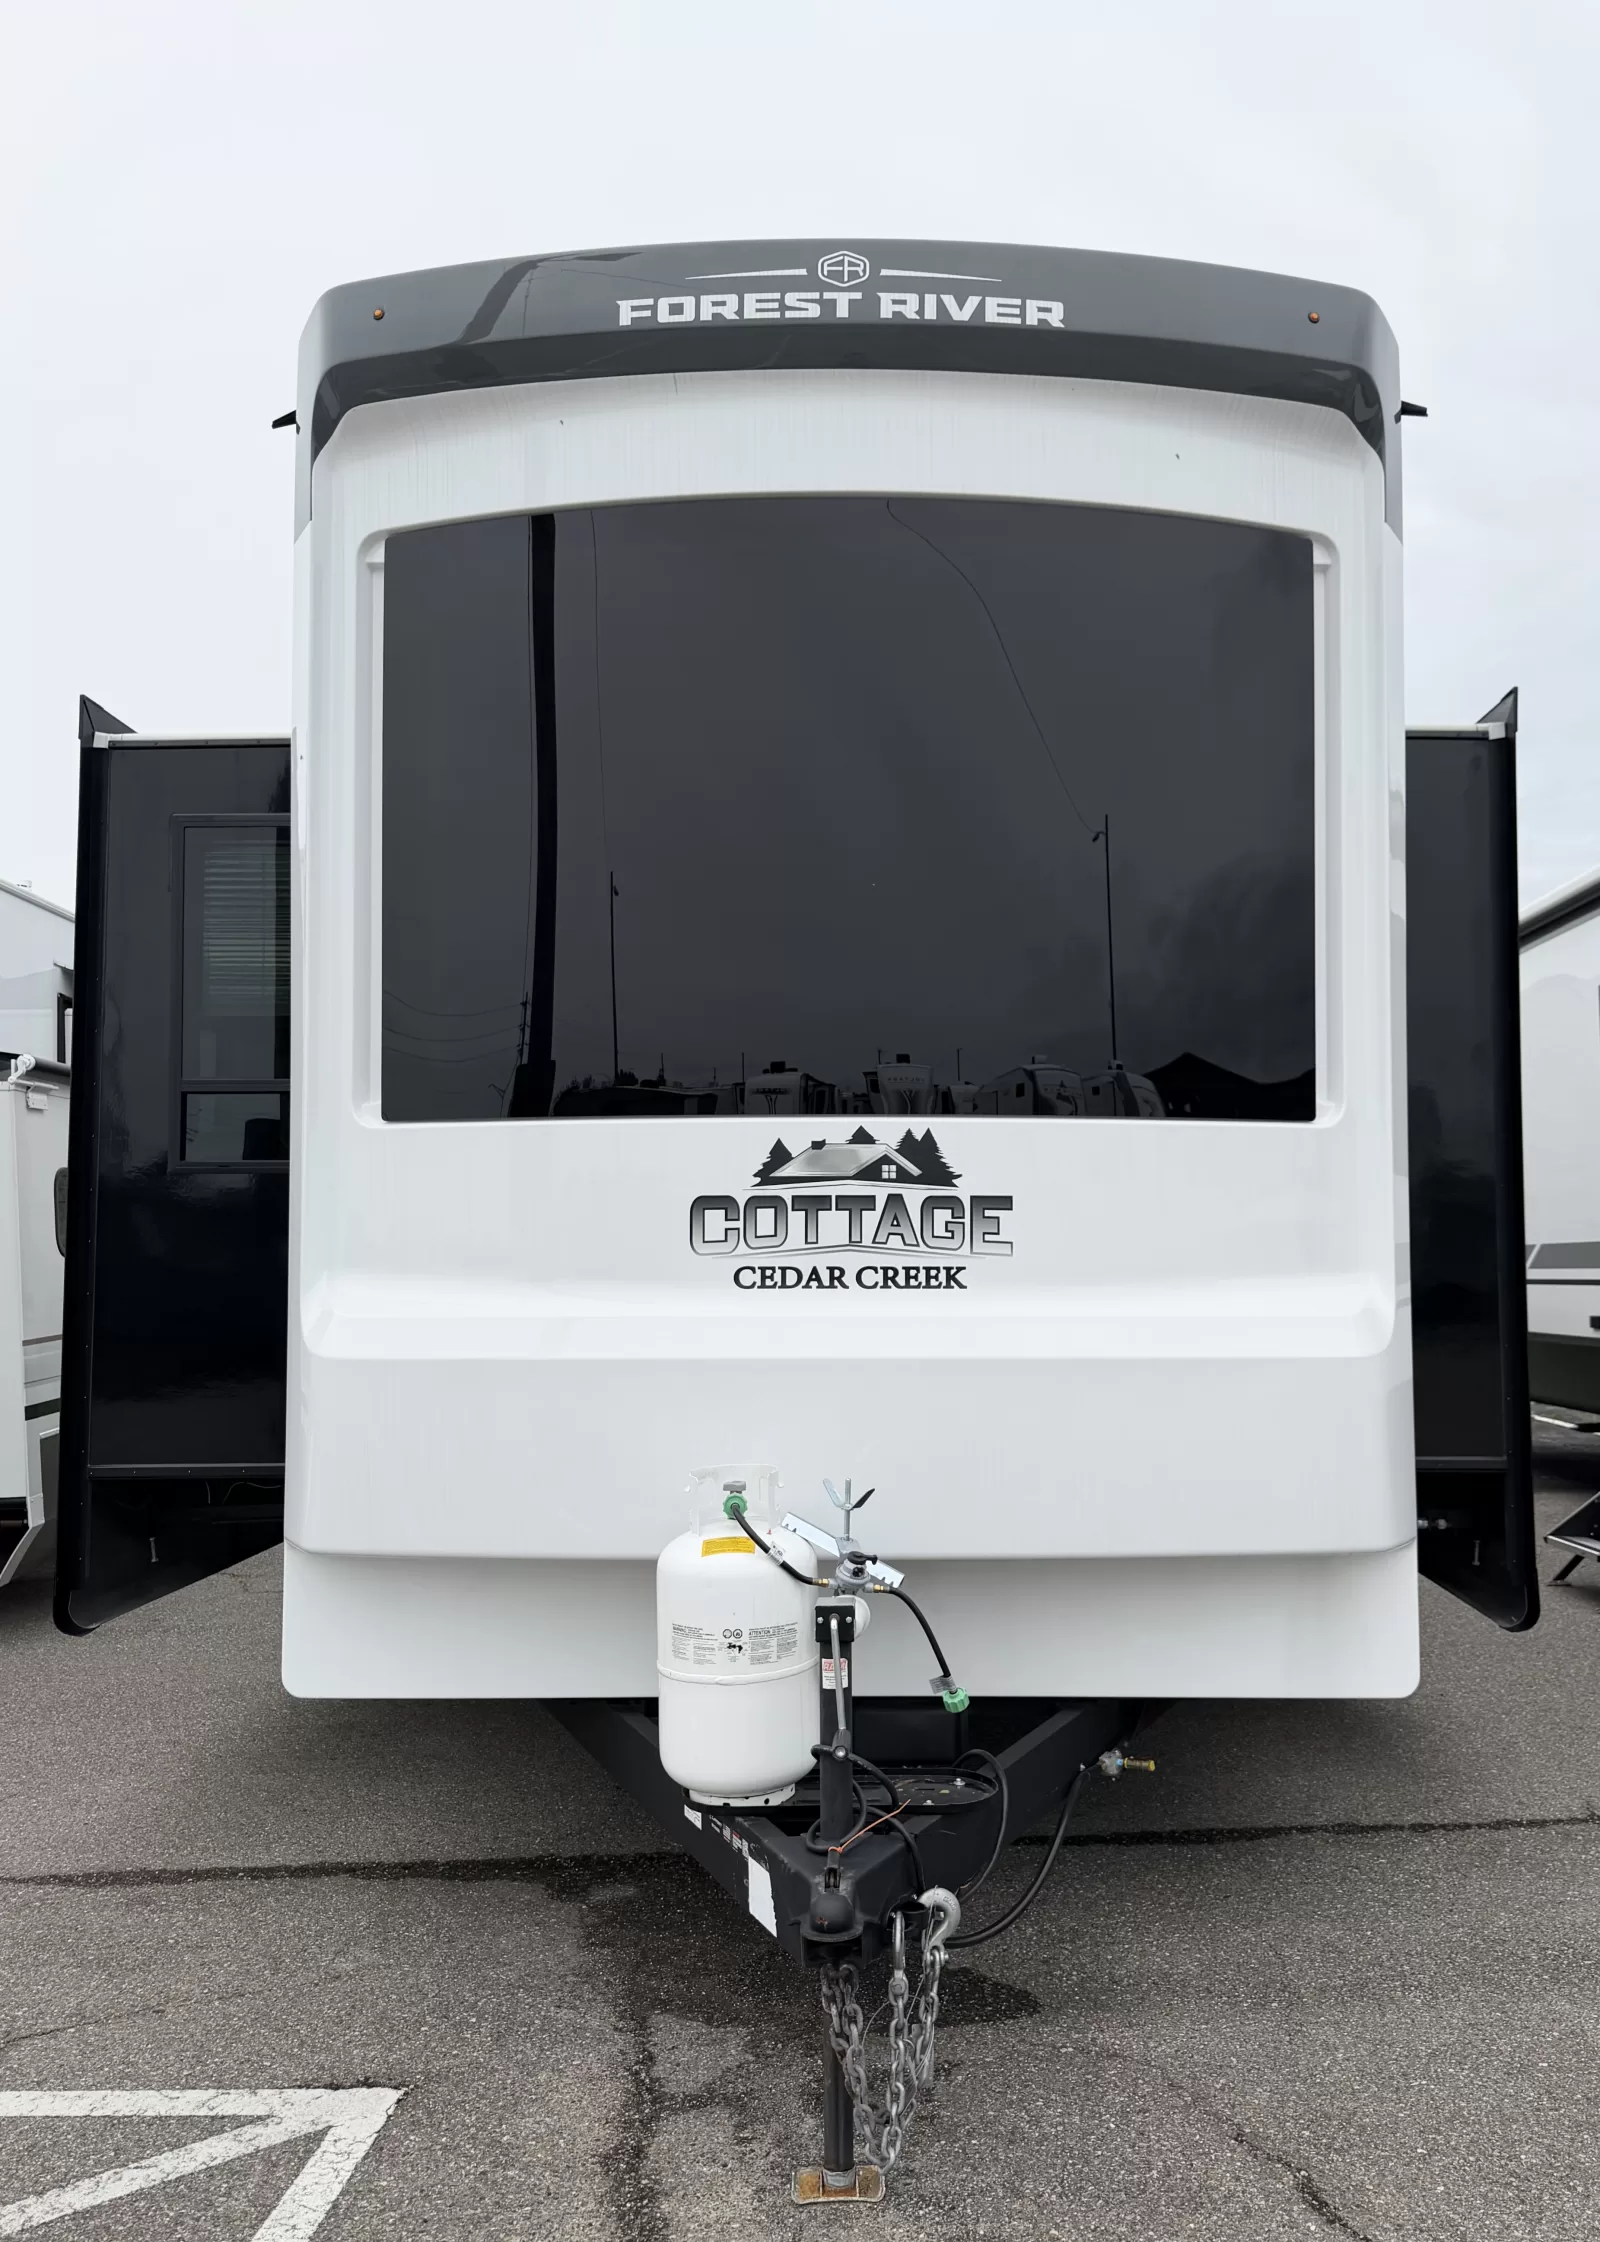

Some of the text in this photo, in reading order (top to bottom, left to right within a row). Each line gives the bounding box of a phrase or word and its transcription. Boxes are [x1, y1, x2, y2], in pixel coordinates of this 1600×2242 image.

[616, 291, 1066, 328] FOREST RIVER
[689, 1193, 1014, 1256] COTTAGE
[733, 1266, 968, 1290] CEDAR CREEK
